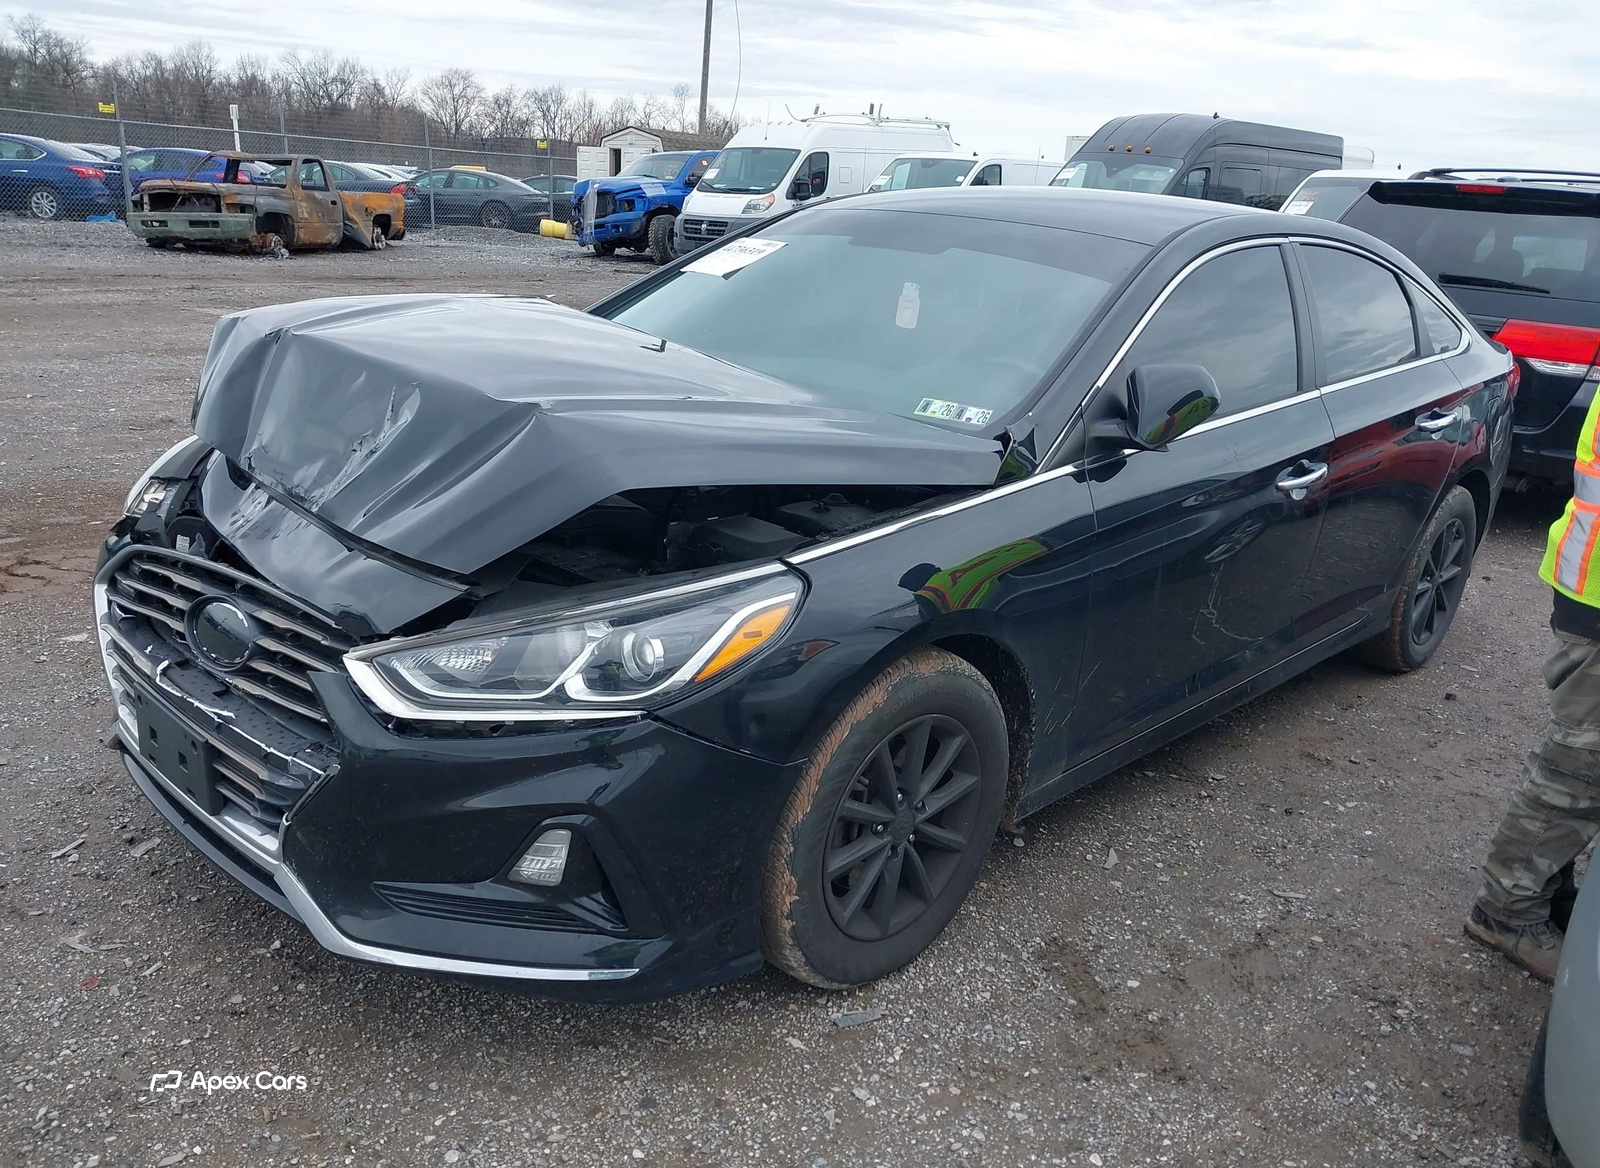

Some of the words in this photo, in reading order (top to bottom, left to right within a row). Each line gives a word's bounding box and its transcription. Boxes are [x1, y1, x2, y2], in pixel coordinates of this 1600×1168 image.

[920, 402, 931, 413] 4
[941, 404, 955, 417] 26
[956, 408, 965, 420] 4
[977, 410, 991, 424] 26
